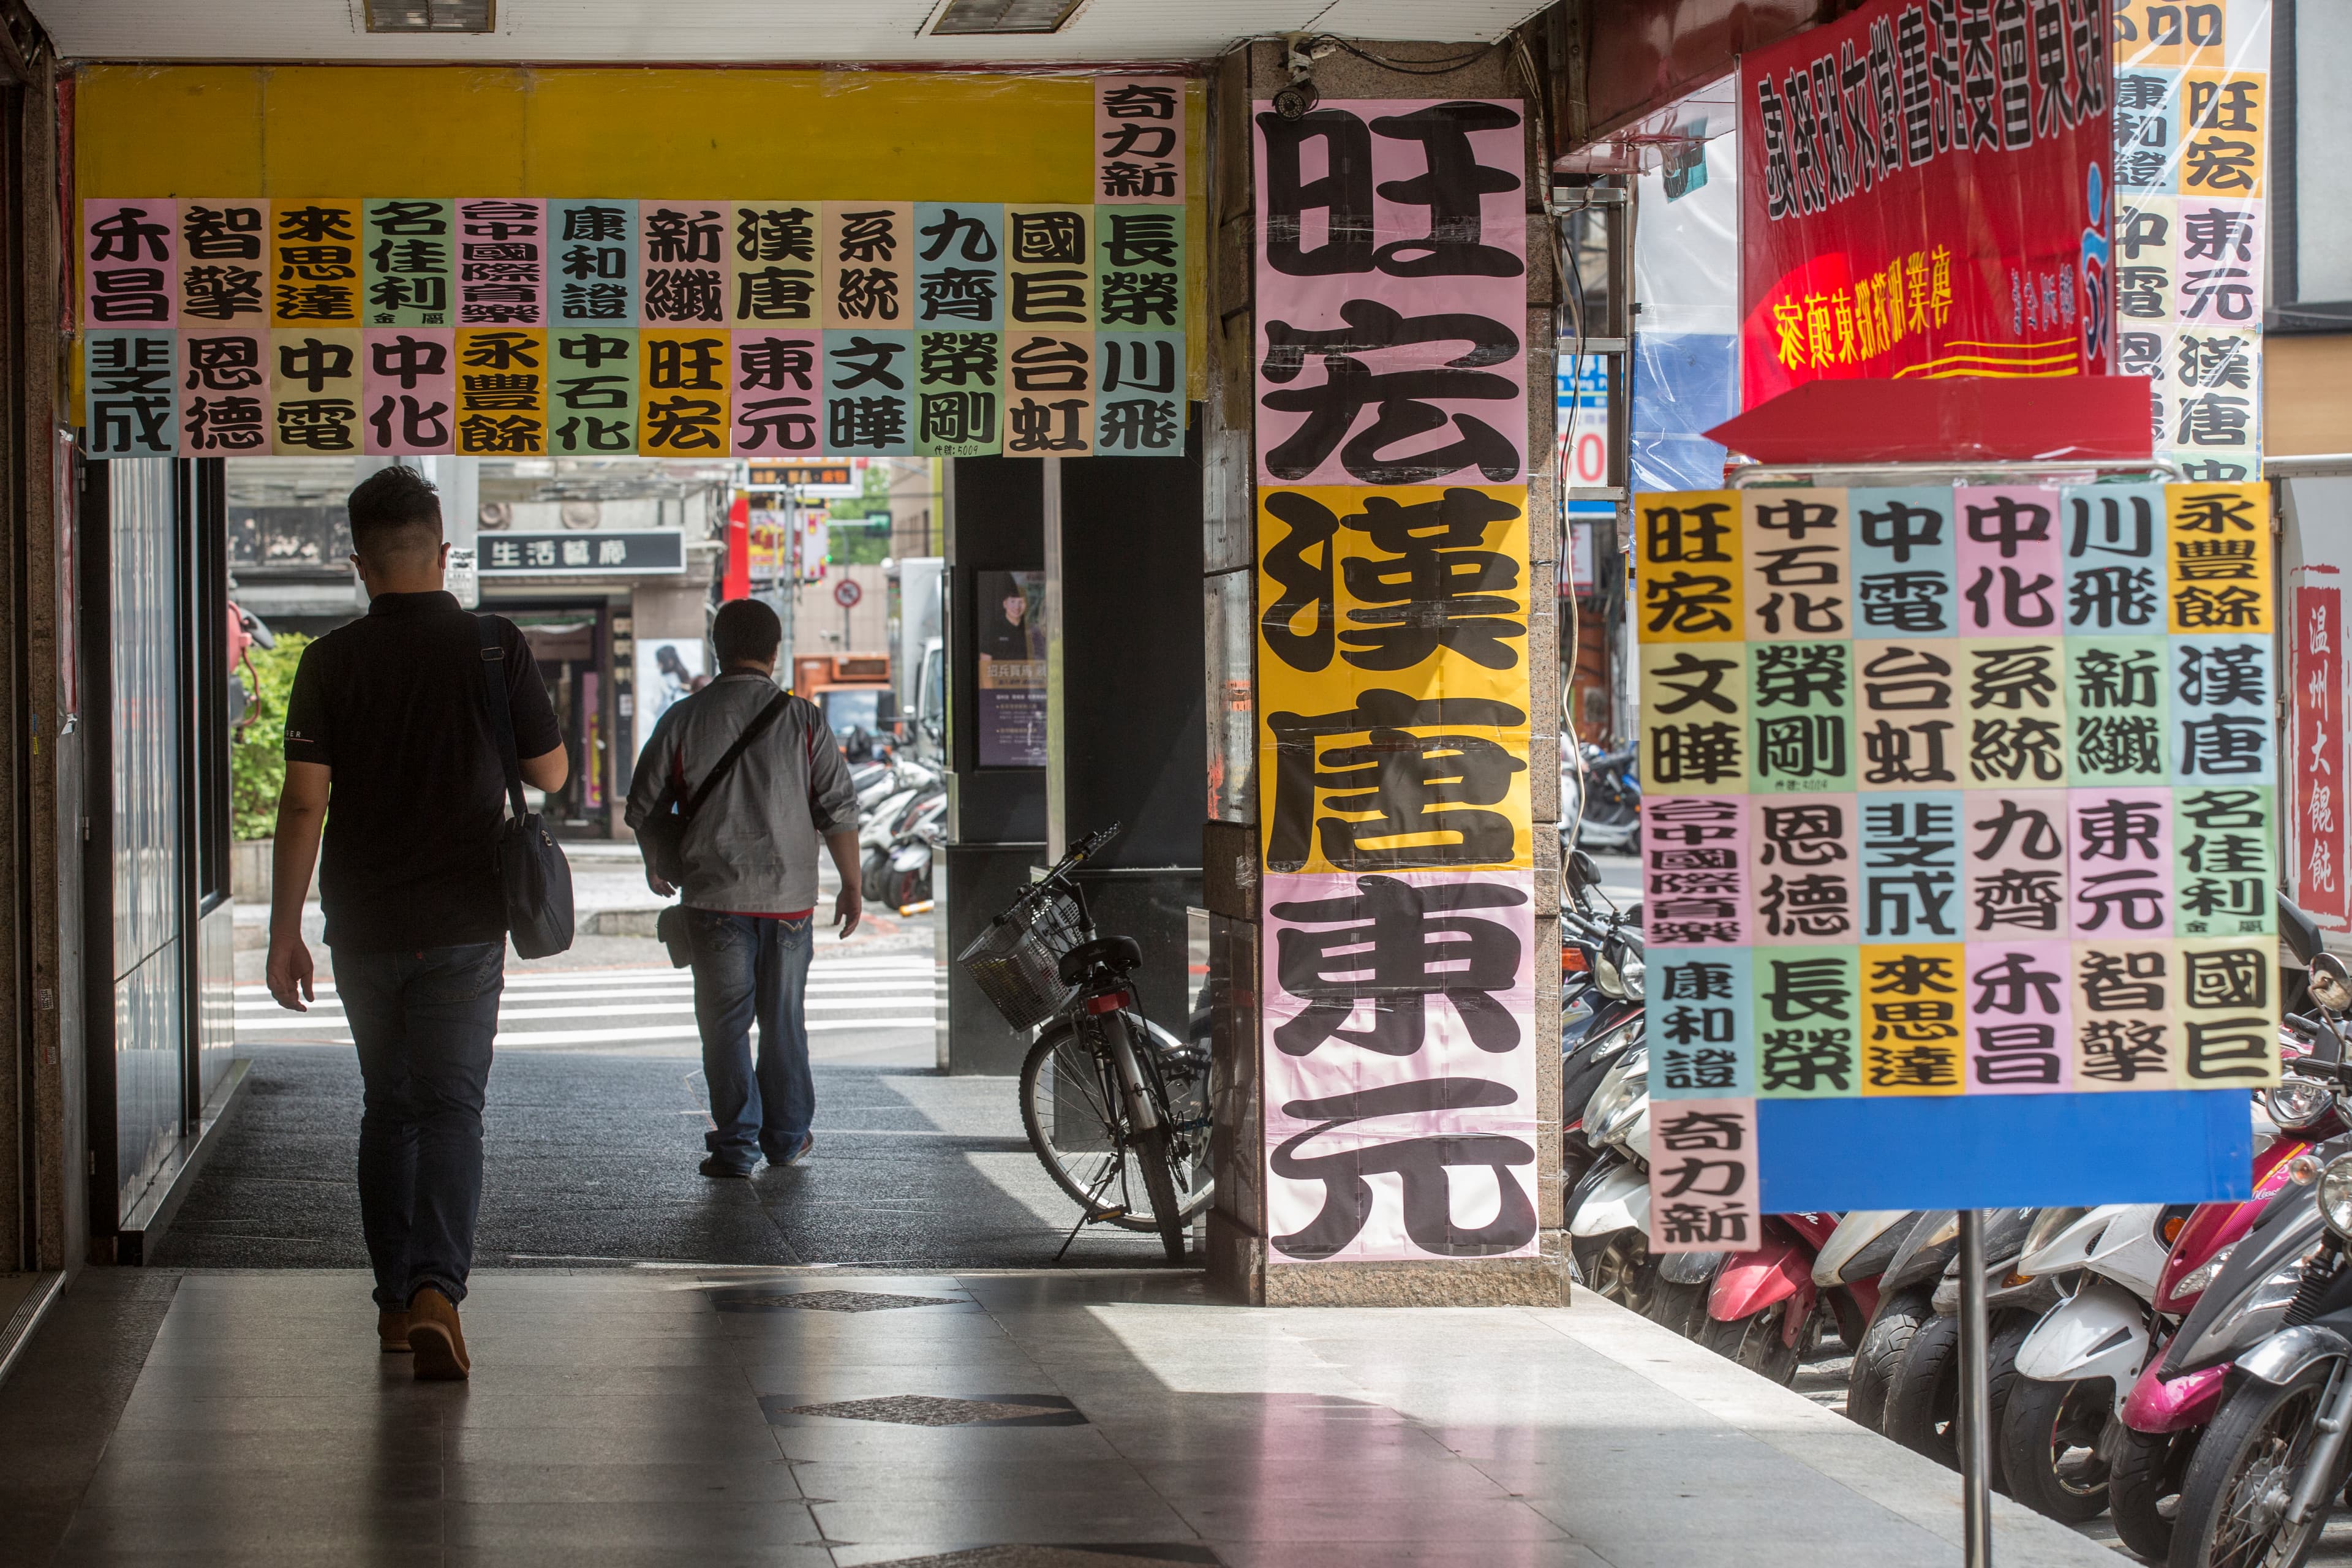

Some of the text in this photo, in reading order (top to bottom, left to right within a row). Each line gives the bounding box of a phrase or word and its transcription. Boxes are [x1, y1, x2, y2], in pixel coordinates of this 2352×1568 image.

[1101, 85, 1177, 197] 奇力新
[2187, 80, 2260, 190] 旺宏
[91, 208, 170, 321] 禾昌
[184, 206, 262, 320] 智擎
[277, 206, 355, 319] 來思達
[369, 203, 448, 311] 名佳利
[462, 203, 540, 323] 台中國際育樂
[561, 206, 627, 318] 康和證
[646, 209, 723, 321] 新纖
[737, 208, 815, 319] 漢唐
[839, 211, 898, 320] 系統
[920, 209, 997, 321] 九齊
[1011, 212, 1088, 323] 國巨
[1101, 214, 1178, 325] 長榮
[1255, 101, 1525, 484] 旺宏
[2114, 206, 2169, 318] 中電
[2181, 208, 2255, 320] 東元
[91, 338, 171, 452] 斐成
[185, 337, 263, 449] 恩德
[277, 338, 355, 450] 中電
[370, 336, 448, 447] 中化
[461, 333, 541, 452] 永豐餘
[556, 334, 630, 450] 中石化
[648, 339, 722, 448] 旺宏
[738, 337, 815, 449] 東元
[829, 337, 906, 448] 文曄
[920, 332, 997, 443] 榮剛
[1010, 337, 1088, 451] 台虹
[1100, 341, 1177, 449] 川飛
[2117, 332, 2164, 441] 恩
[2177, 335, 2252, 445] 漢唐
[1643, 502, 1734, 635] 旺宏
[1754, 497, 1845, 635] 中石化
[1857, 500, 1950, 633] 中電
[1964, 495, 2056, 629] 中化
[2068, 496, 2158, 629] 川飛
[2173, 492, 2261, 628] 永豐餘
[1262, 488, 1526, 872] 漢唐
[1649, 651, 1744, 786] 文曄
[1754, 643, 1849, 778] 榮剛
[1862, 646, 1956, 785] 台虹
[1969, 644, 2062, 782] 系統
[2075, 647, 2163, 775] 新纖
[2178, 643, 2268, 776] 漢唐
[1648, 799, 1742, 944] 台中國際育樂
[1758, 803, 1852, 937] 恩德
[1864, 802, 1957, 937] 斐成
[1973, 799, 2064, 932] 九齊
[2077, 798, 2165, 932] 東元
[2179, 790, 2267, 918] 名佳利
[1270, 875, 1536, 1260] 東元
[1660, 960, 1738, 1090] 康和證
[1760, 957, 1853, 1092] 長榮
[1869, 954, 1960, 1088] 來思達
[1972, 952, 2062, 1085] 禾昌
[2079, 950, 2169, 1083] 智擎
[2183, 948, 2271, 1080] 國巨
[1659, 1110, 1750, 1244] 奇力新
